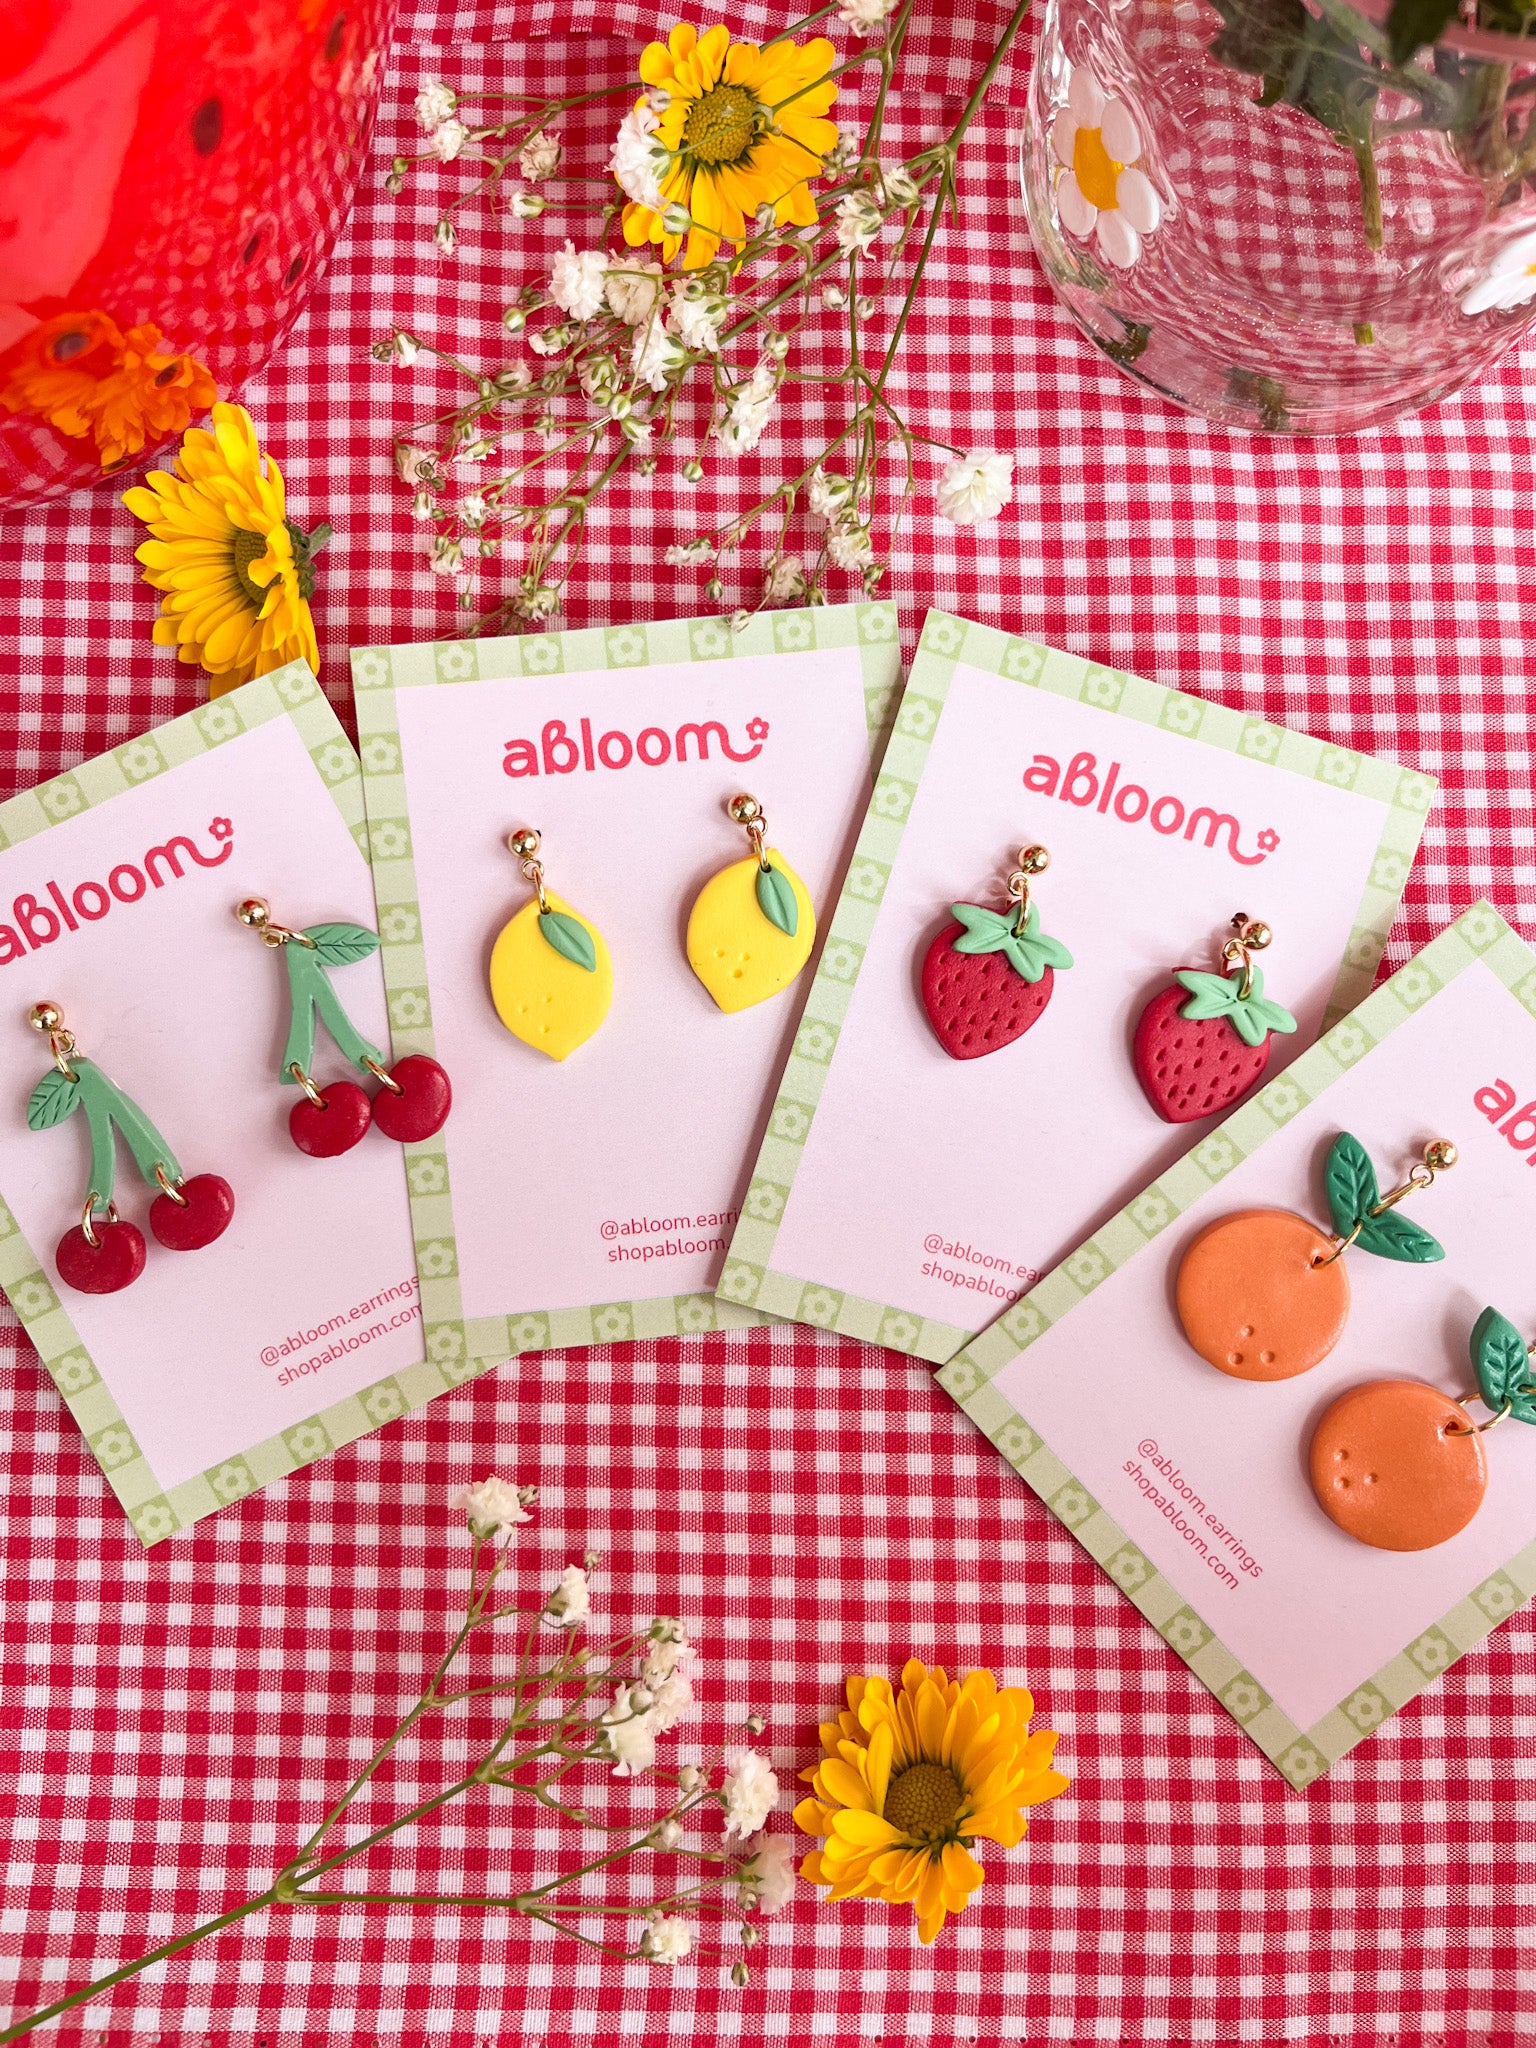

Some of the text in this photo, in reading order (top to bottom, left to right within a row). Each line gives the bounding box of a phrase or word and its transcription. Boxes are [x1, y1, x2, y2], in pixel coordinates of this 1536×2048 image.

[600, 1207, 742, 1240] @abloom.earri
[260, 1275, 419, 1367] @abloom.earrings
[1122, 1459, 1239, 1590] shopabloom.com
[1137, 1438, 1263, 1578] @abloom.earrings
